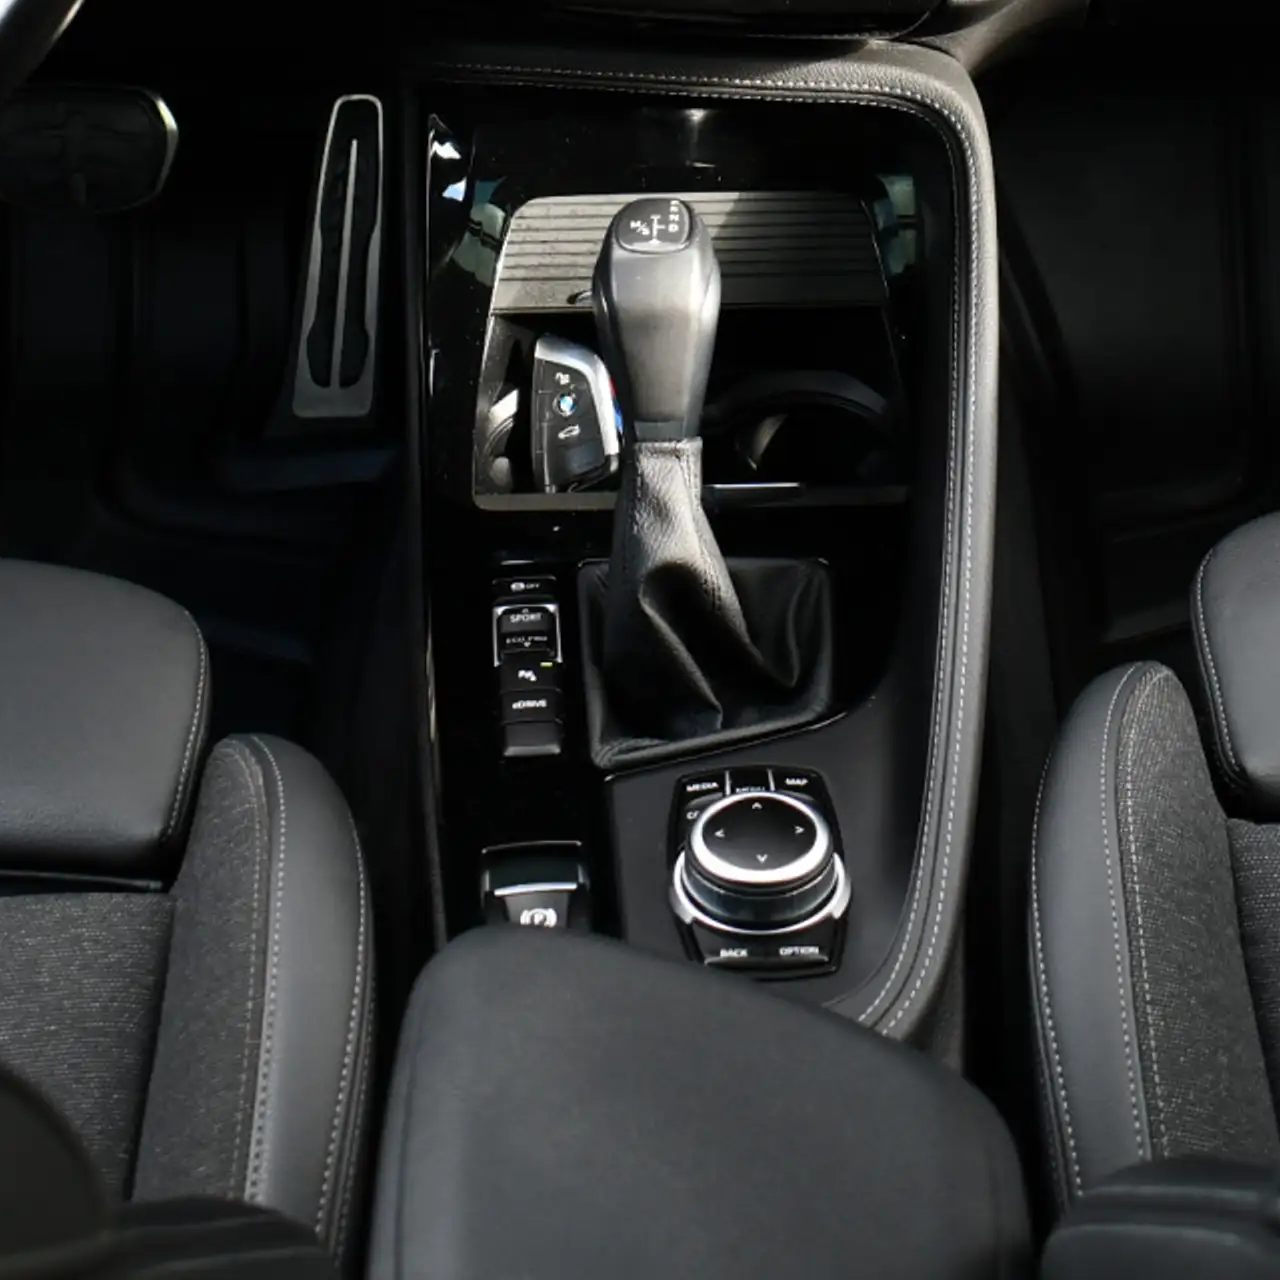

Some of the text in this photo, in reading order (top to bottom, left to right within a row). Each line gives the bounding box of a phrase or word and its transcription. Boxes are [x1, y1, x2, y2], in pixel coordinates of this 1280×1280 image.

[510, 613, 541, 623] SPORT
[686, 782, 719, 792] MEDIA
[720, 948, 748, 958] BACK
[779, 946, 819, 956] OPTION
